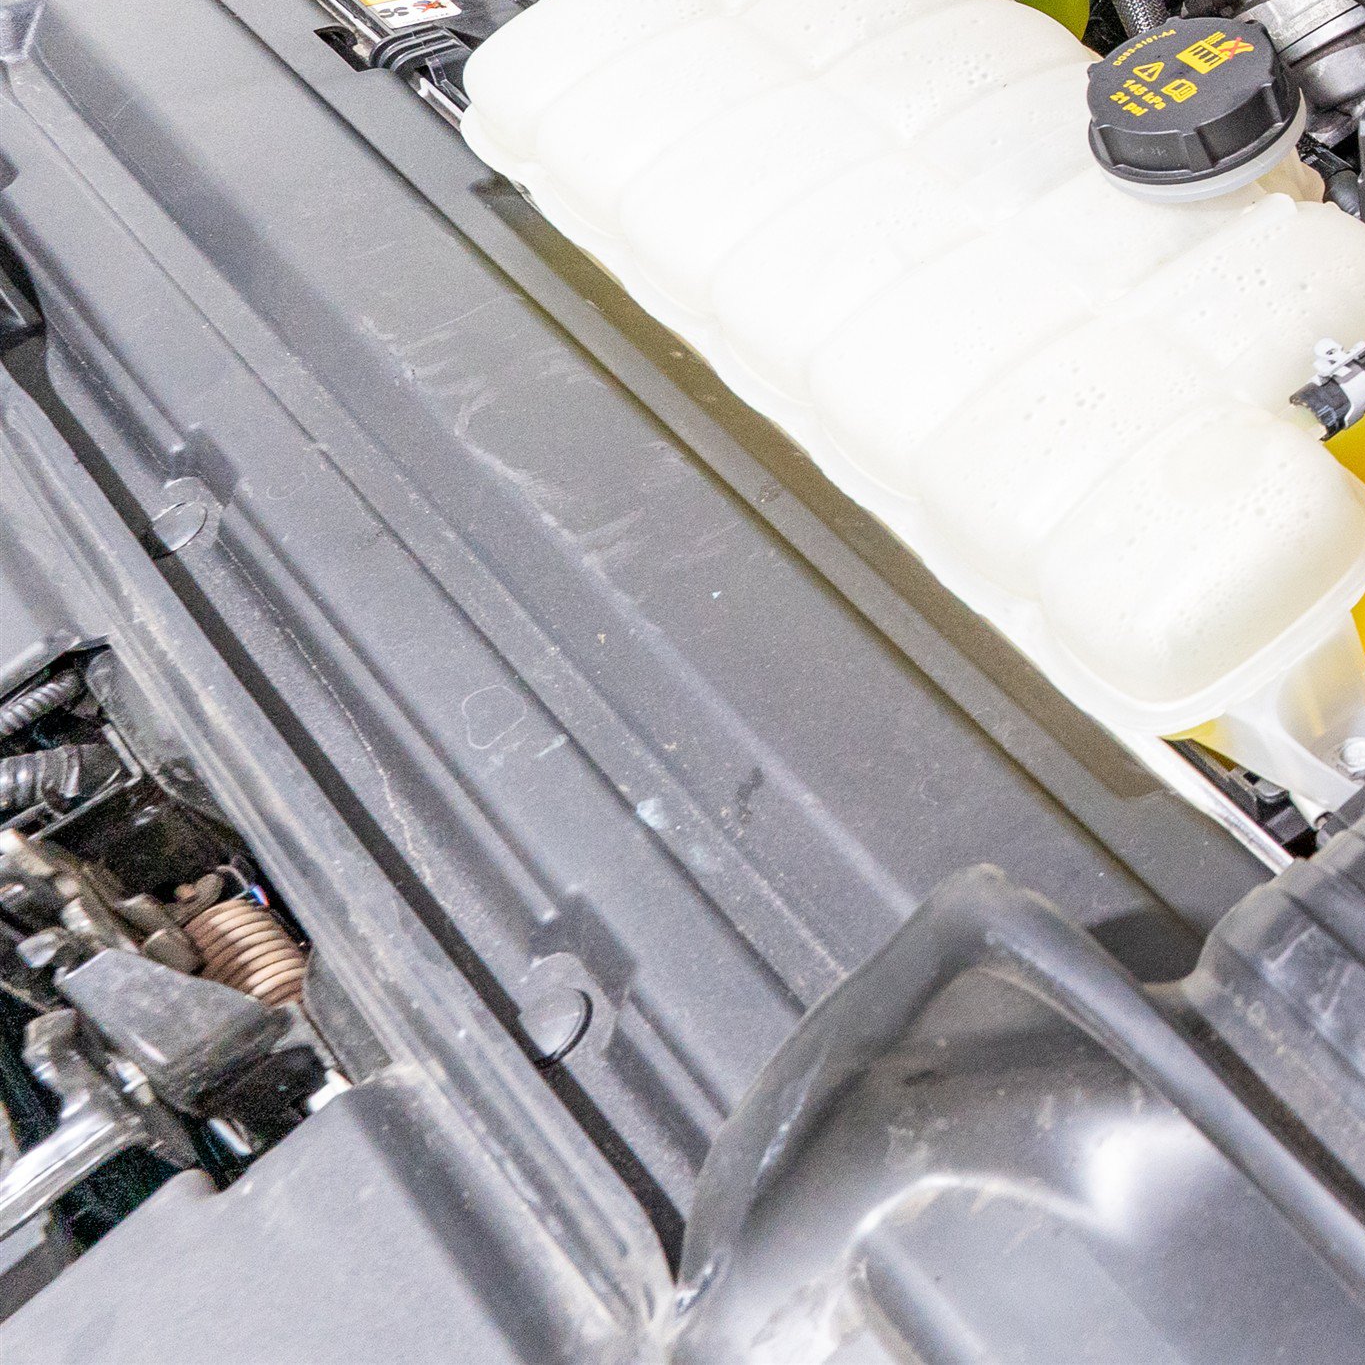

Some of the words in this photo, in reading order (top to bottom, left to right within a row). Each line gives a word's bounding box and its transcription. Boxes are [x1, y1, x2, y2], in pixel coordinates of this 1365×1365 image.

[1109, 92, 1131, 105] 21
[1122, 100, 1149, 117] psi
[1122, 79, 1144, 97] 145
[1142, 90, 1167, 110] kPa
